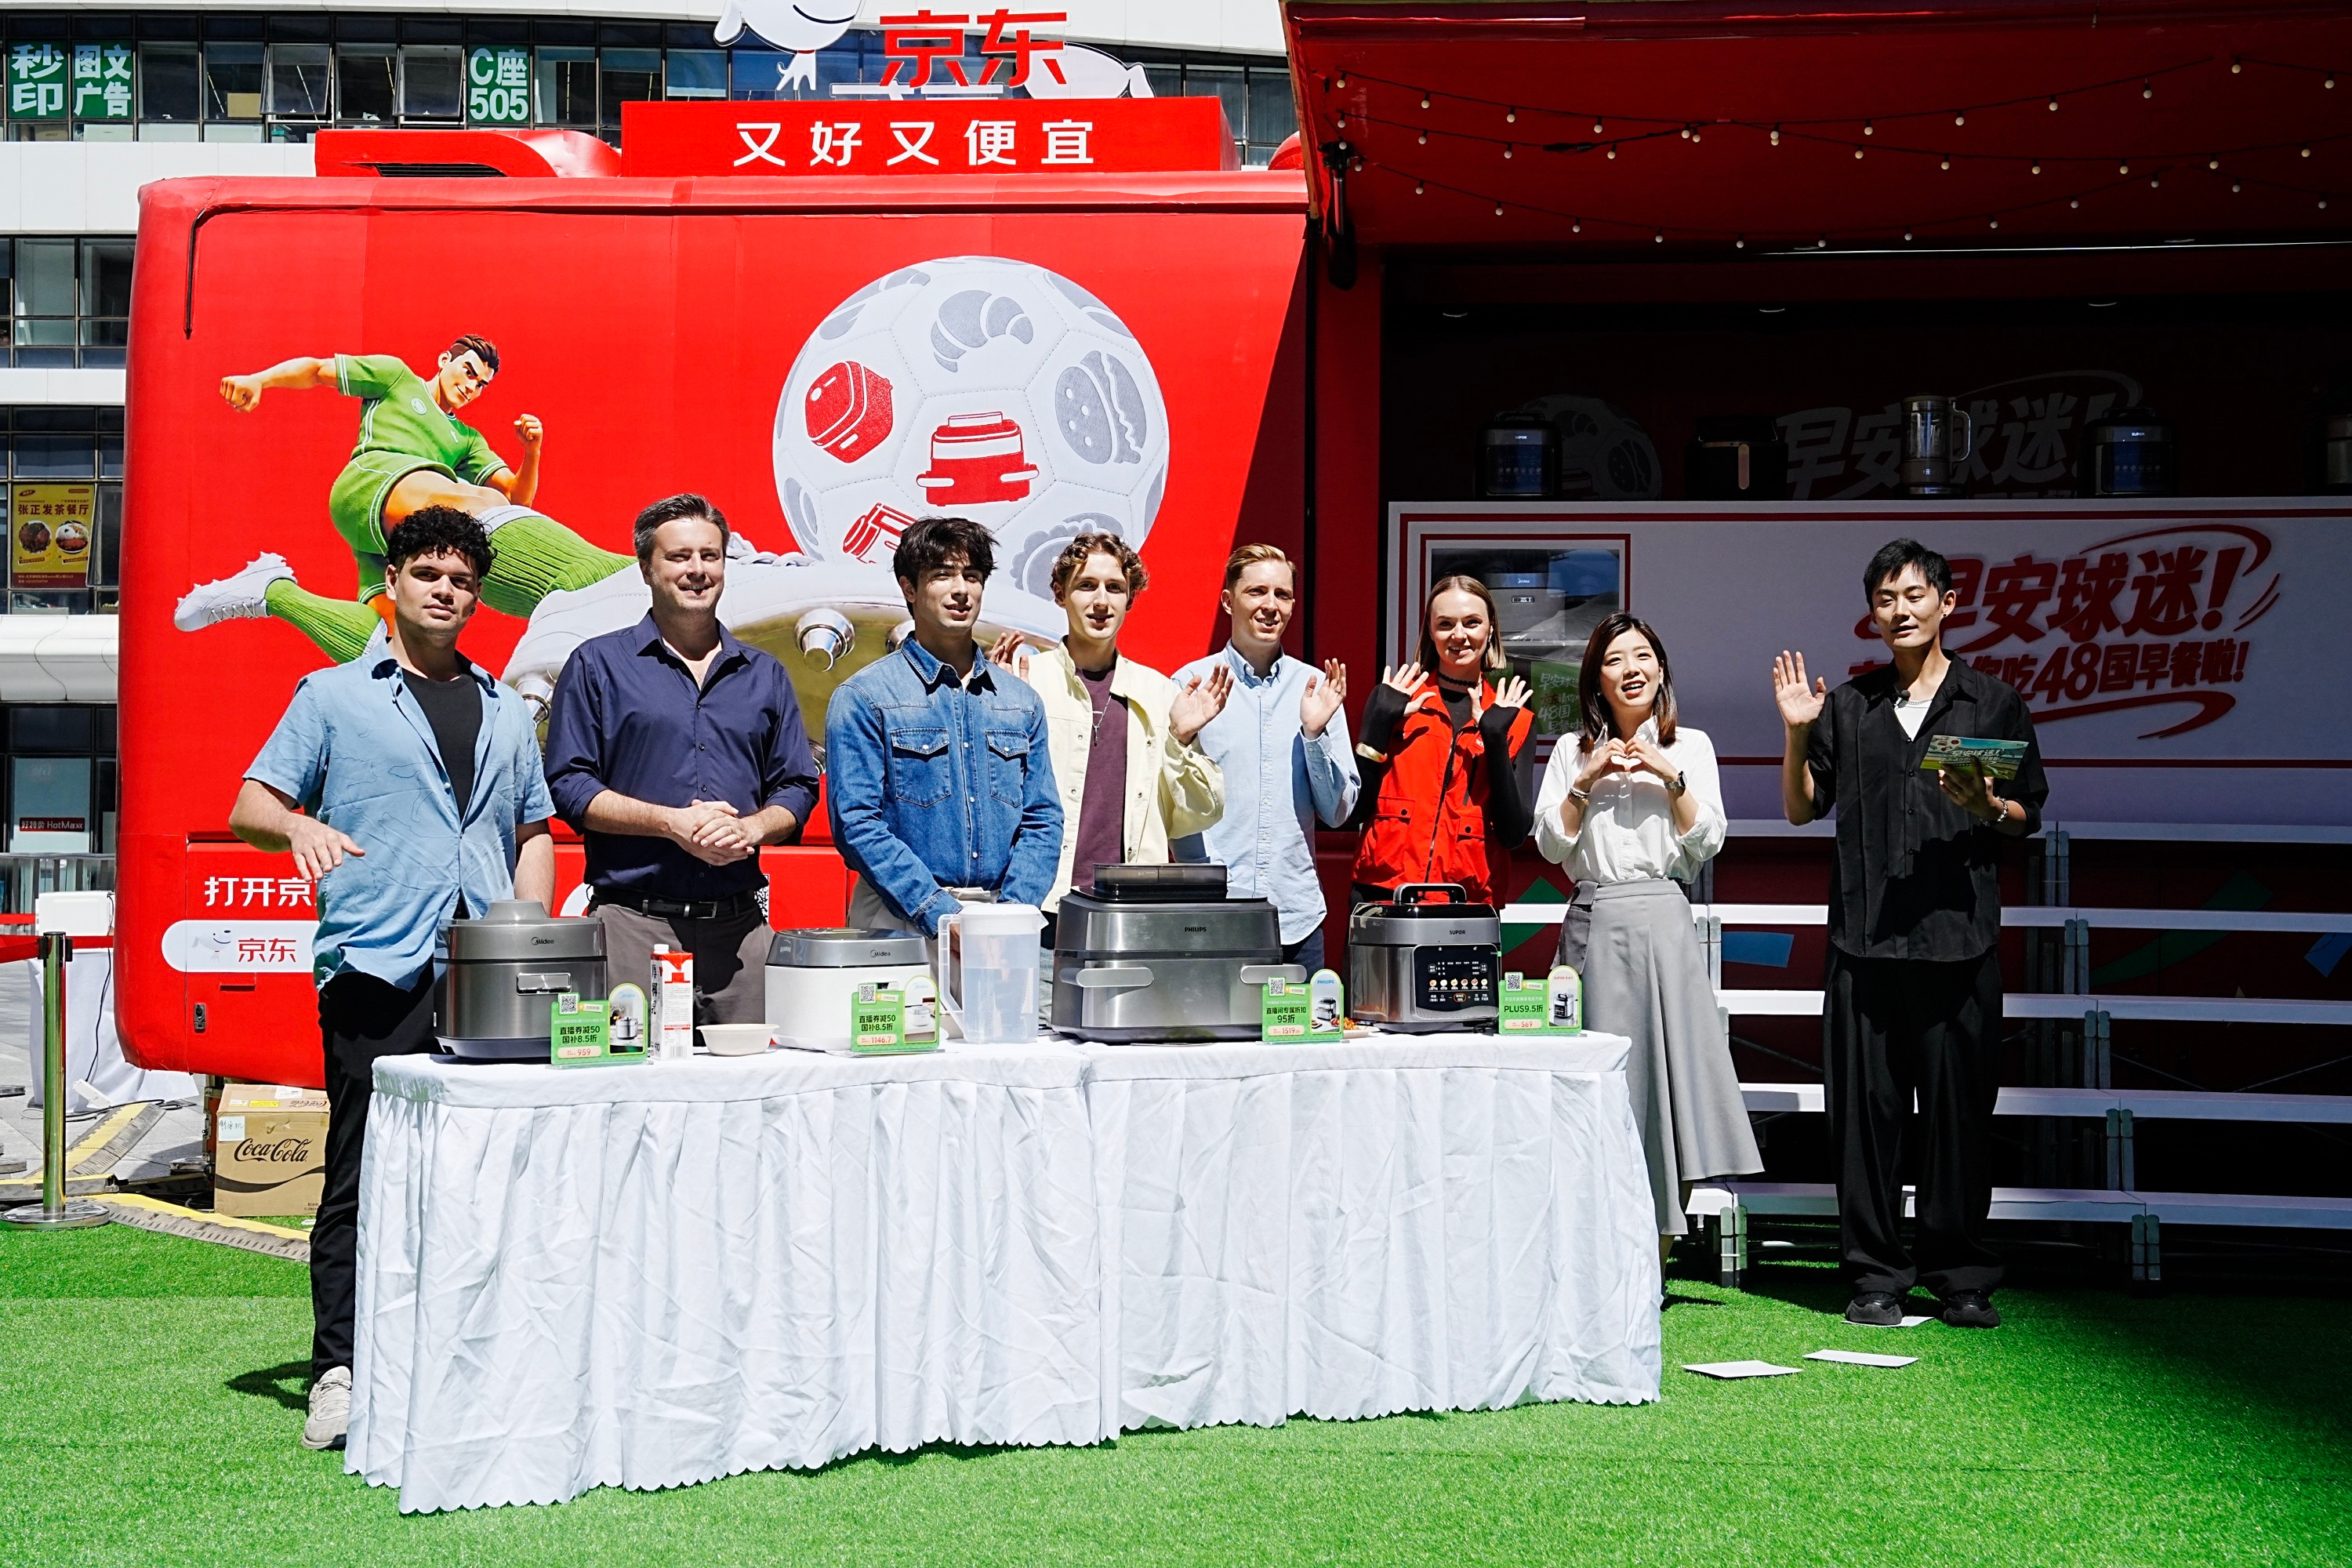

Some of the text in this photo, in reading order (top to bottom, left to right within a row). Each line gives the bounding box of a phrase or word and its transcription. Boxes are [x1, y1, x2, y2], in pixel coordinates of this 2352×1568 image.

[880, 9, 1067, 88] 京东
[74, 45, 132, 79] 图文
[470, 48, 528, 86] C座
[74, 82, 132, 116] 广告
[470, 88, 528, 121] 505
[734, 119, 1094, 166] 又好又便宜
[18, 504, 89, 515] 张正发茶餐厅
[1537, 704, 1570, 721] 48国
[205, 877, 317, 907] 打开京
[238, 938, 296, 962] 京东
[560, 1025, 601, 1035] 直播券减50
[858, 1014, 896, 1023] 直播券减50
[861, 1023, 893, 1032] 国补8.5折
[1277, 1014, 1295, 1023] 95折
[562, 1034, 597, 1044] 国补8.5折
[234, 1138, 314, 1162] Coca-Cola
